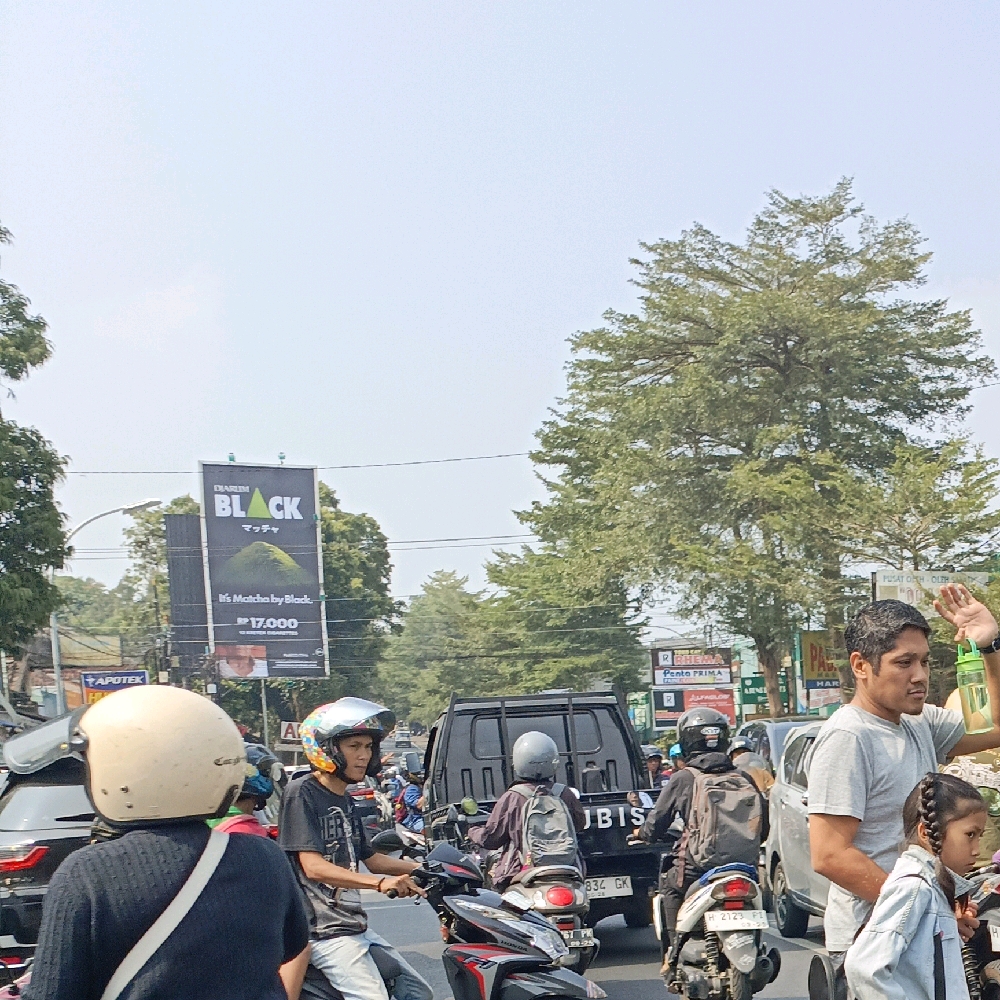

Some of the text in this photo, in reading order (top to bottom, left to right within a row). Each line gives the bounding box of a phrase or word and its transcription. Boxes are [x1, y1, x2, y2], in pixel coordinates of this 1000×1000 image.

[232, 594, 270, 603] Matcha
[270, 594, 285, 606] by
[249, 617, 298, 628] 17.000
[663, 669, 691, 677] Penta
[94, 675, 145, 686] APOTEK
[615, 877, 630, 890] GK
[500, 939, 529, 952] HONDA
